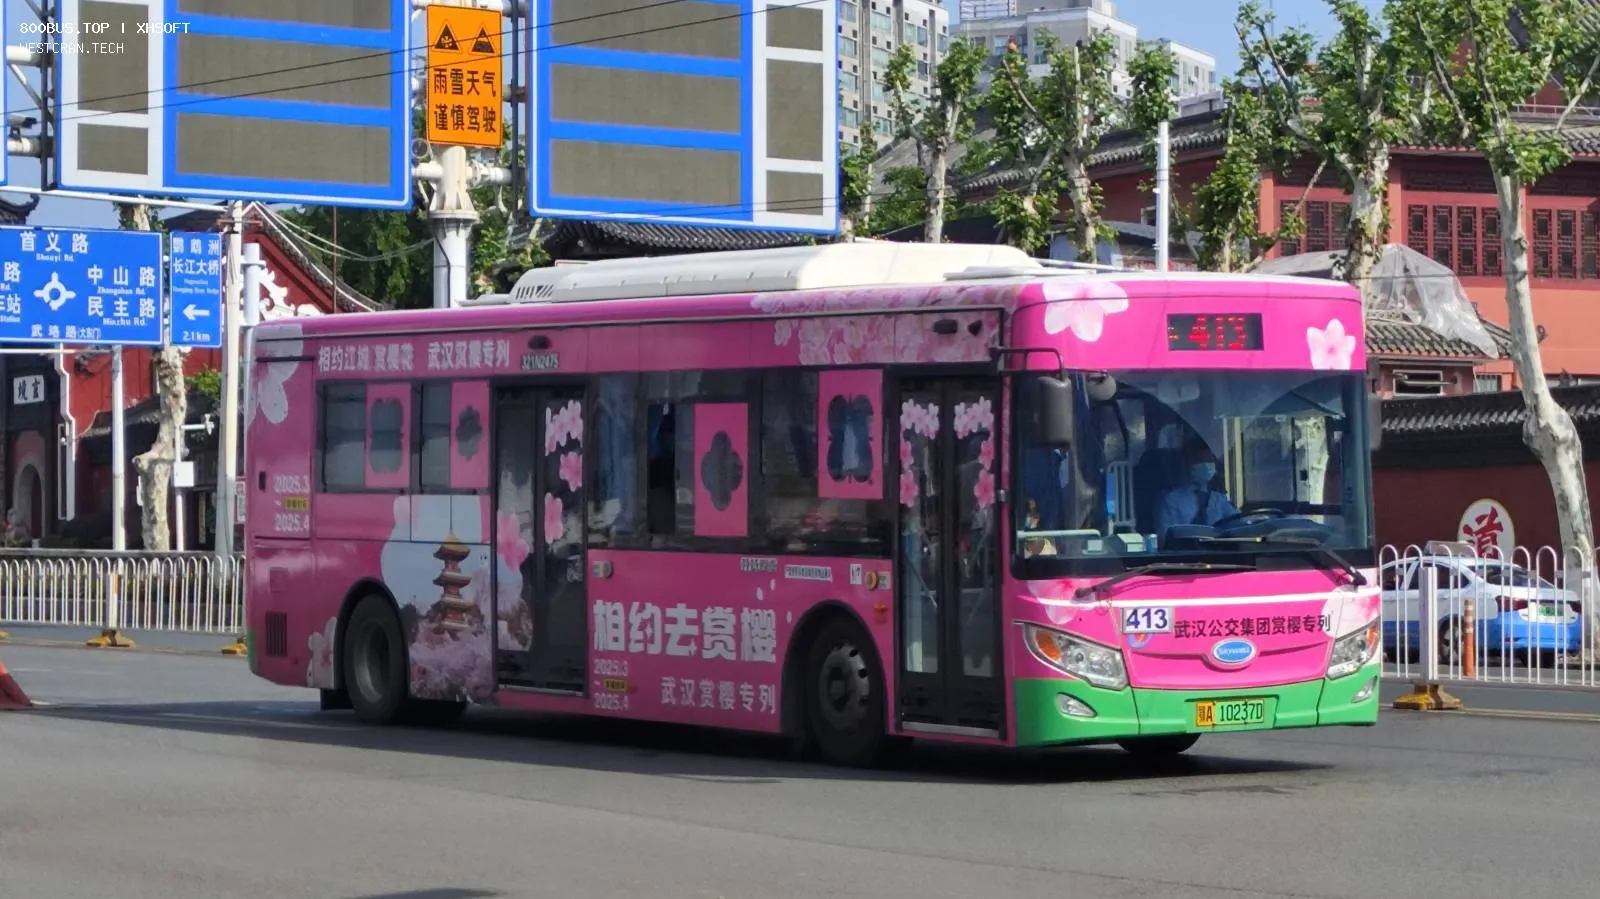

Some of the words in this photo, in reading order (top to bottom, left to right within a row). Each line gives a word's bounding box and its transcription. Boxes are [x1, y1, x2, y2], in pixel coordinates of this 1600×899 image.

[433, 68, 497, 97] 雨雪天气
[433, 103, 497, 133] 谨慎驾驶
[20, 231, 89, 254] 首义路
[4, 261, 21, 283] 路
[87, 264, 156, 288] 中山路
[173, 257, 220, 276] 长江大桥
[87, 295, 156, 319] 民主路
[1188, 316, 1247, 349] 413
[1462, 506, 1504, 560] 道
[593, 599, 777, 663] 相约去赏樱
[1125, 608, 1169, 630] 413
[1173, 614, 1332, 639] 武汉公交集团赏樱专列
[660, 676, 777, 715] 武汉赏樱专列
[1219, 702, 1263, 722] 10237D
